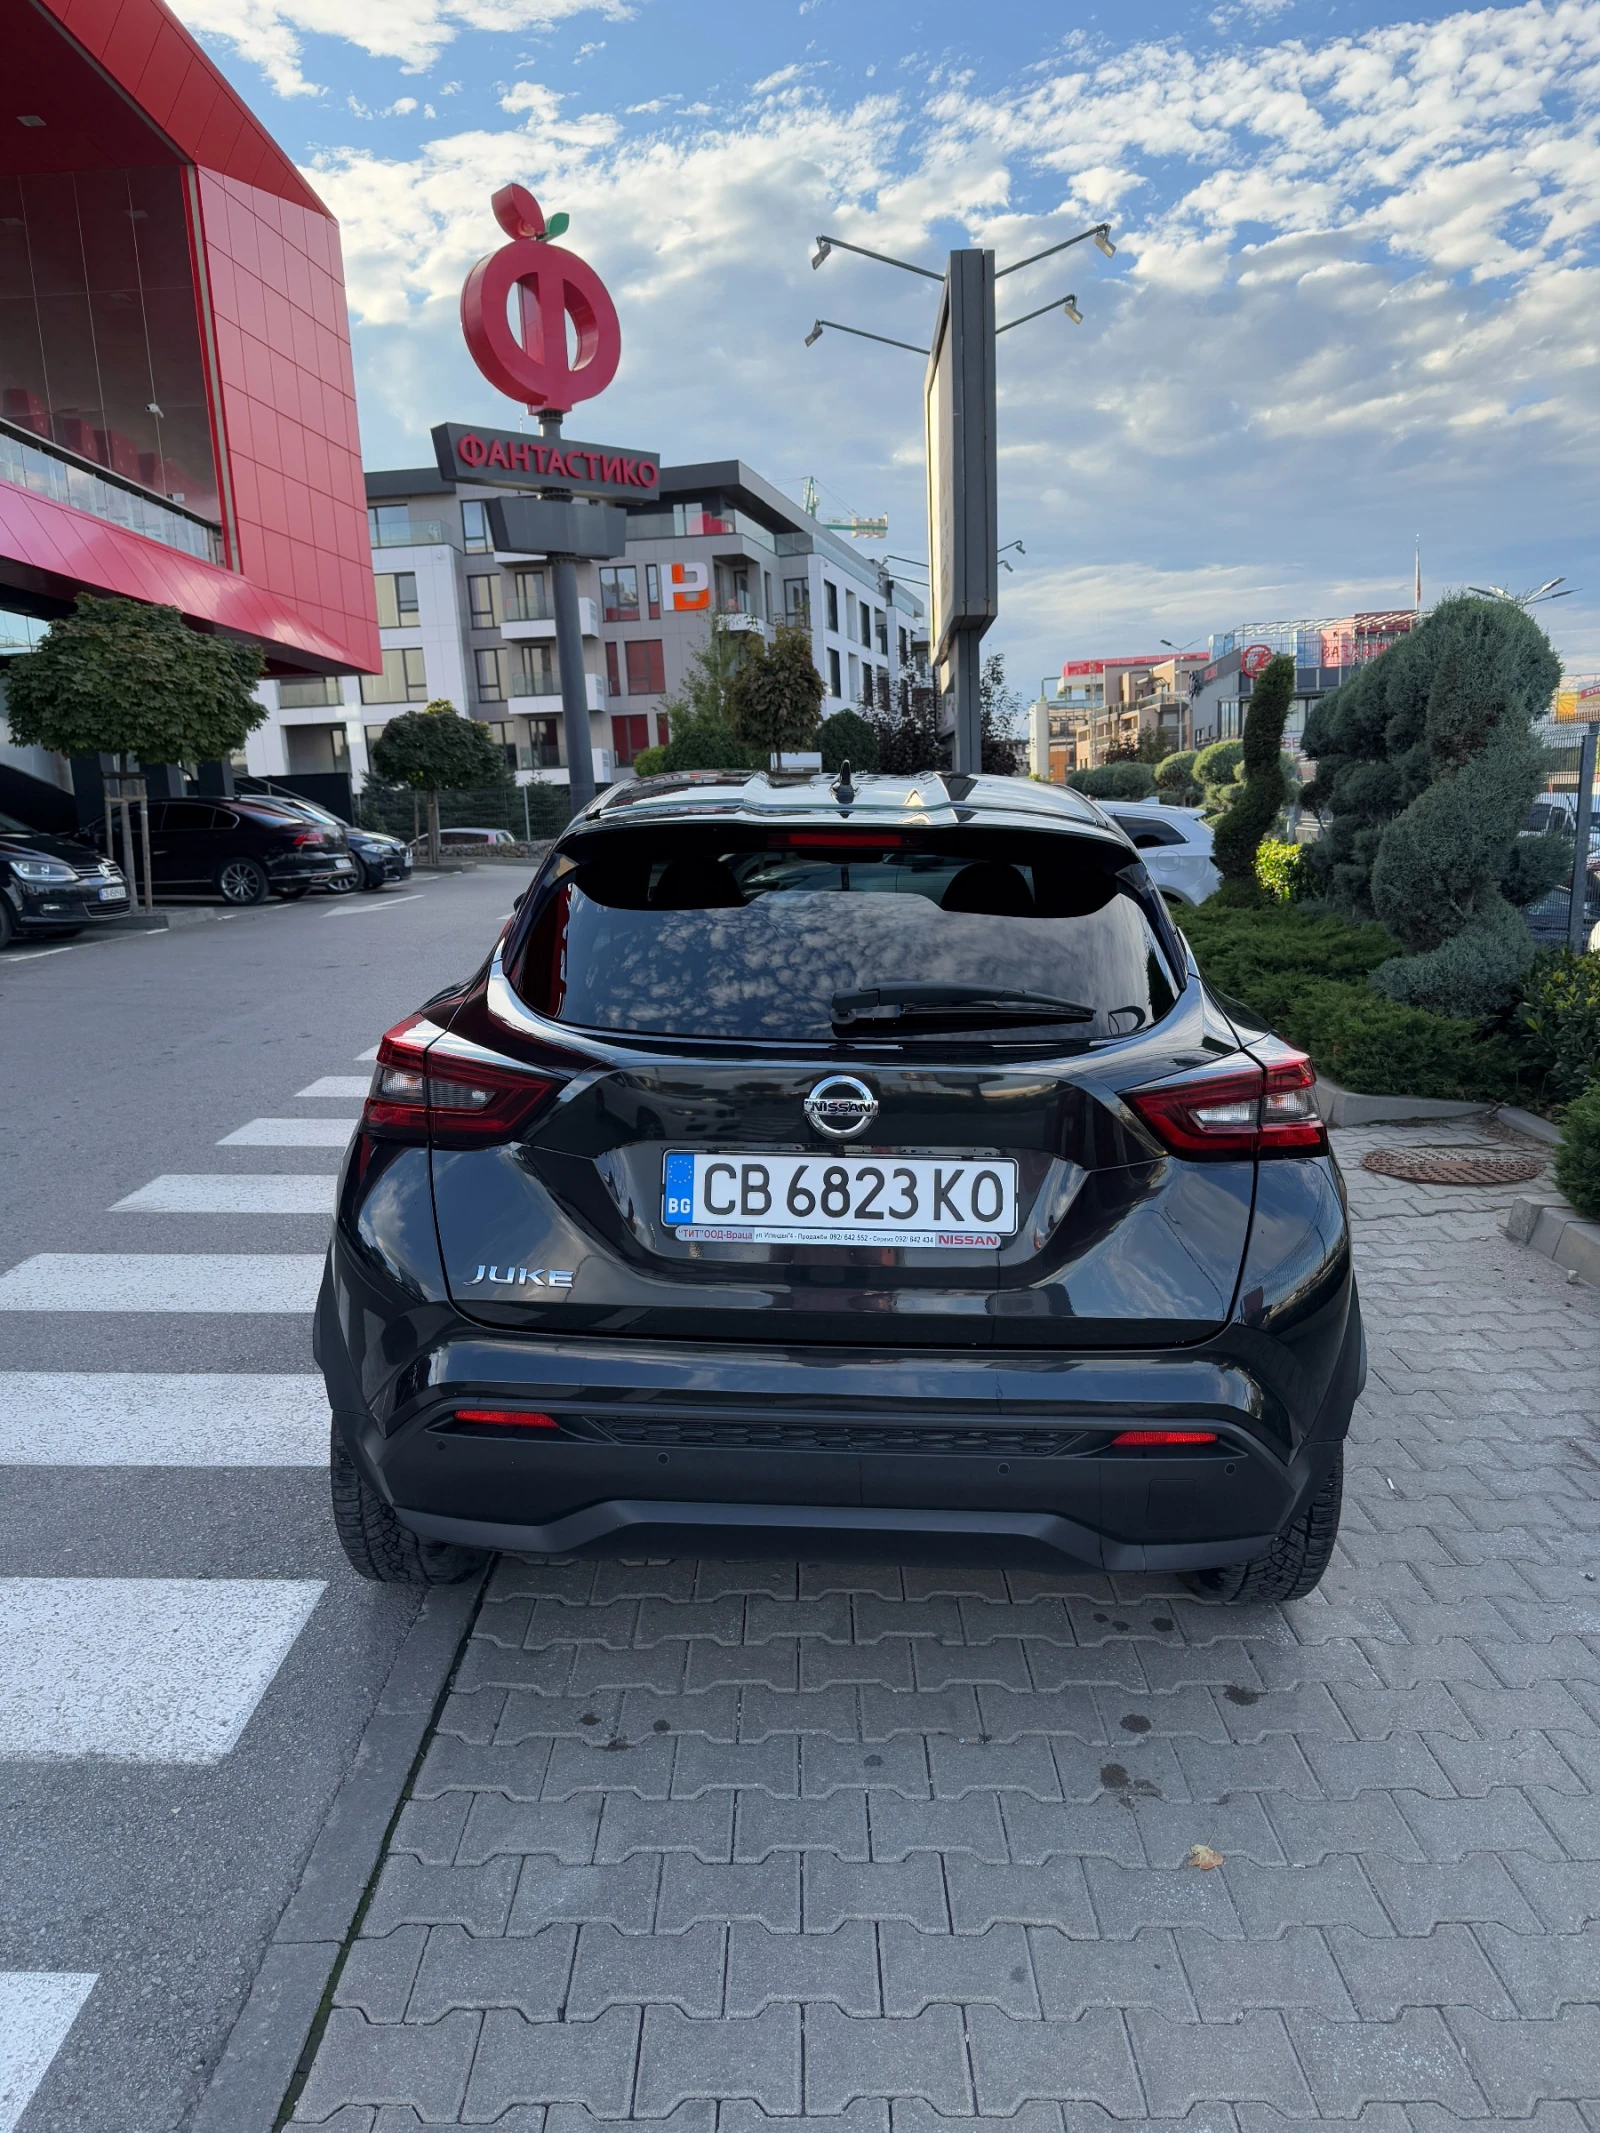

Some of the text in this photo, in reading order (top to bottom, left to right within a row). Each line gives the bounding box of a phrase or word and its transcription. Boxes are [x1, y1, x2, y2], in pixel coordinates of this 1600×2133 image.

[458, 433, 658, 488] ФАНТАСТИКО
[812, 1101, 871, 1113] NISSAN
[704, 1163, 772, 1216] CB
[786, 1165, 919, 1220] 6823
[668, 1198, 691, 1214] BG
[938, 1235, 997, 1246] NISSAN
[463, 1265, 574, 1288] JUKE
